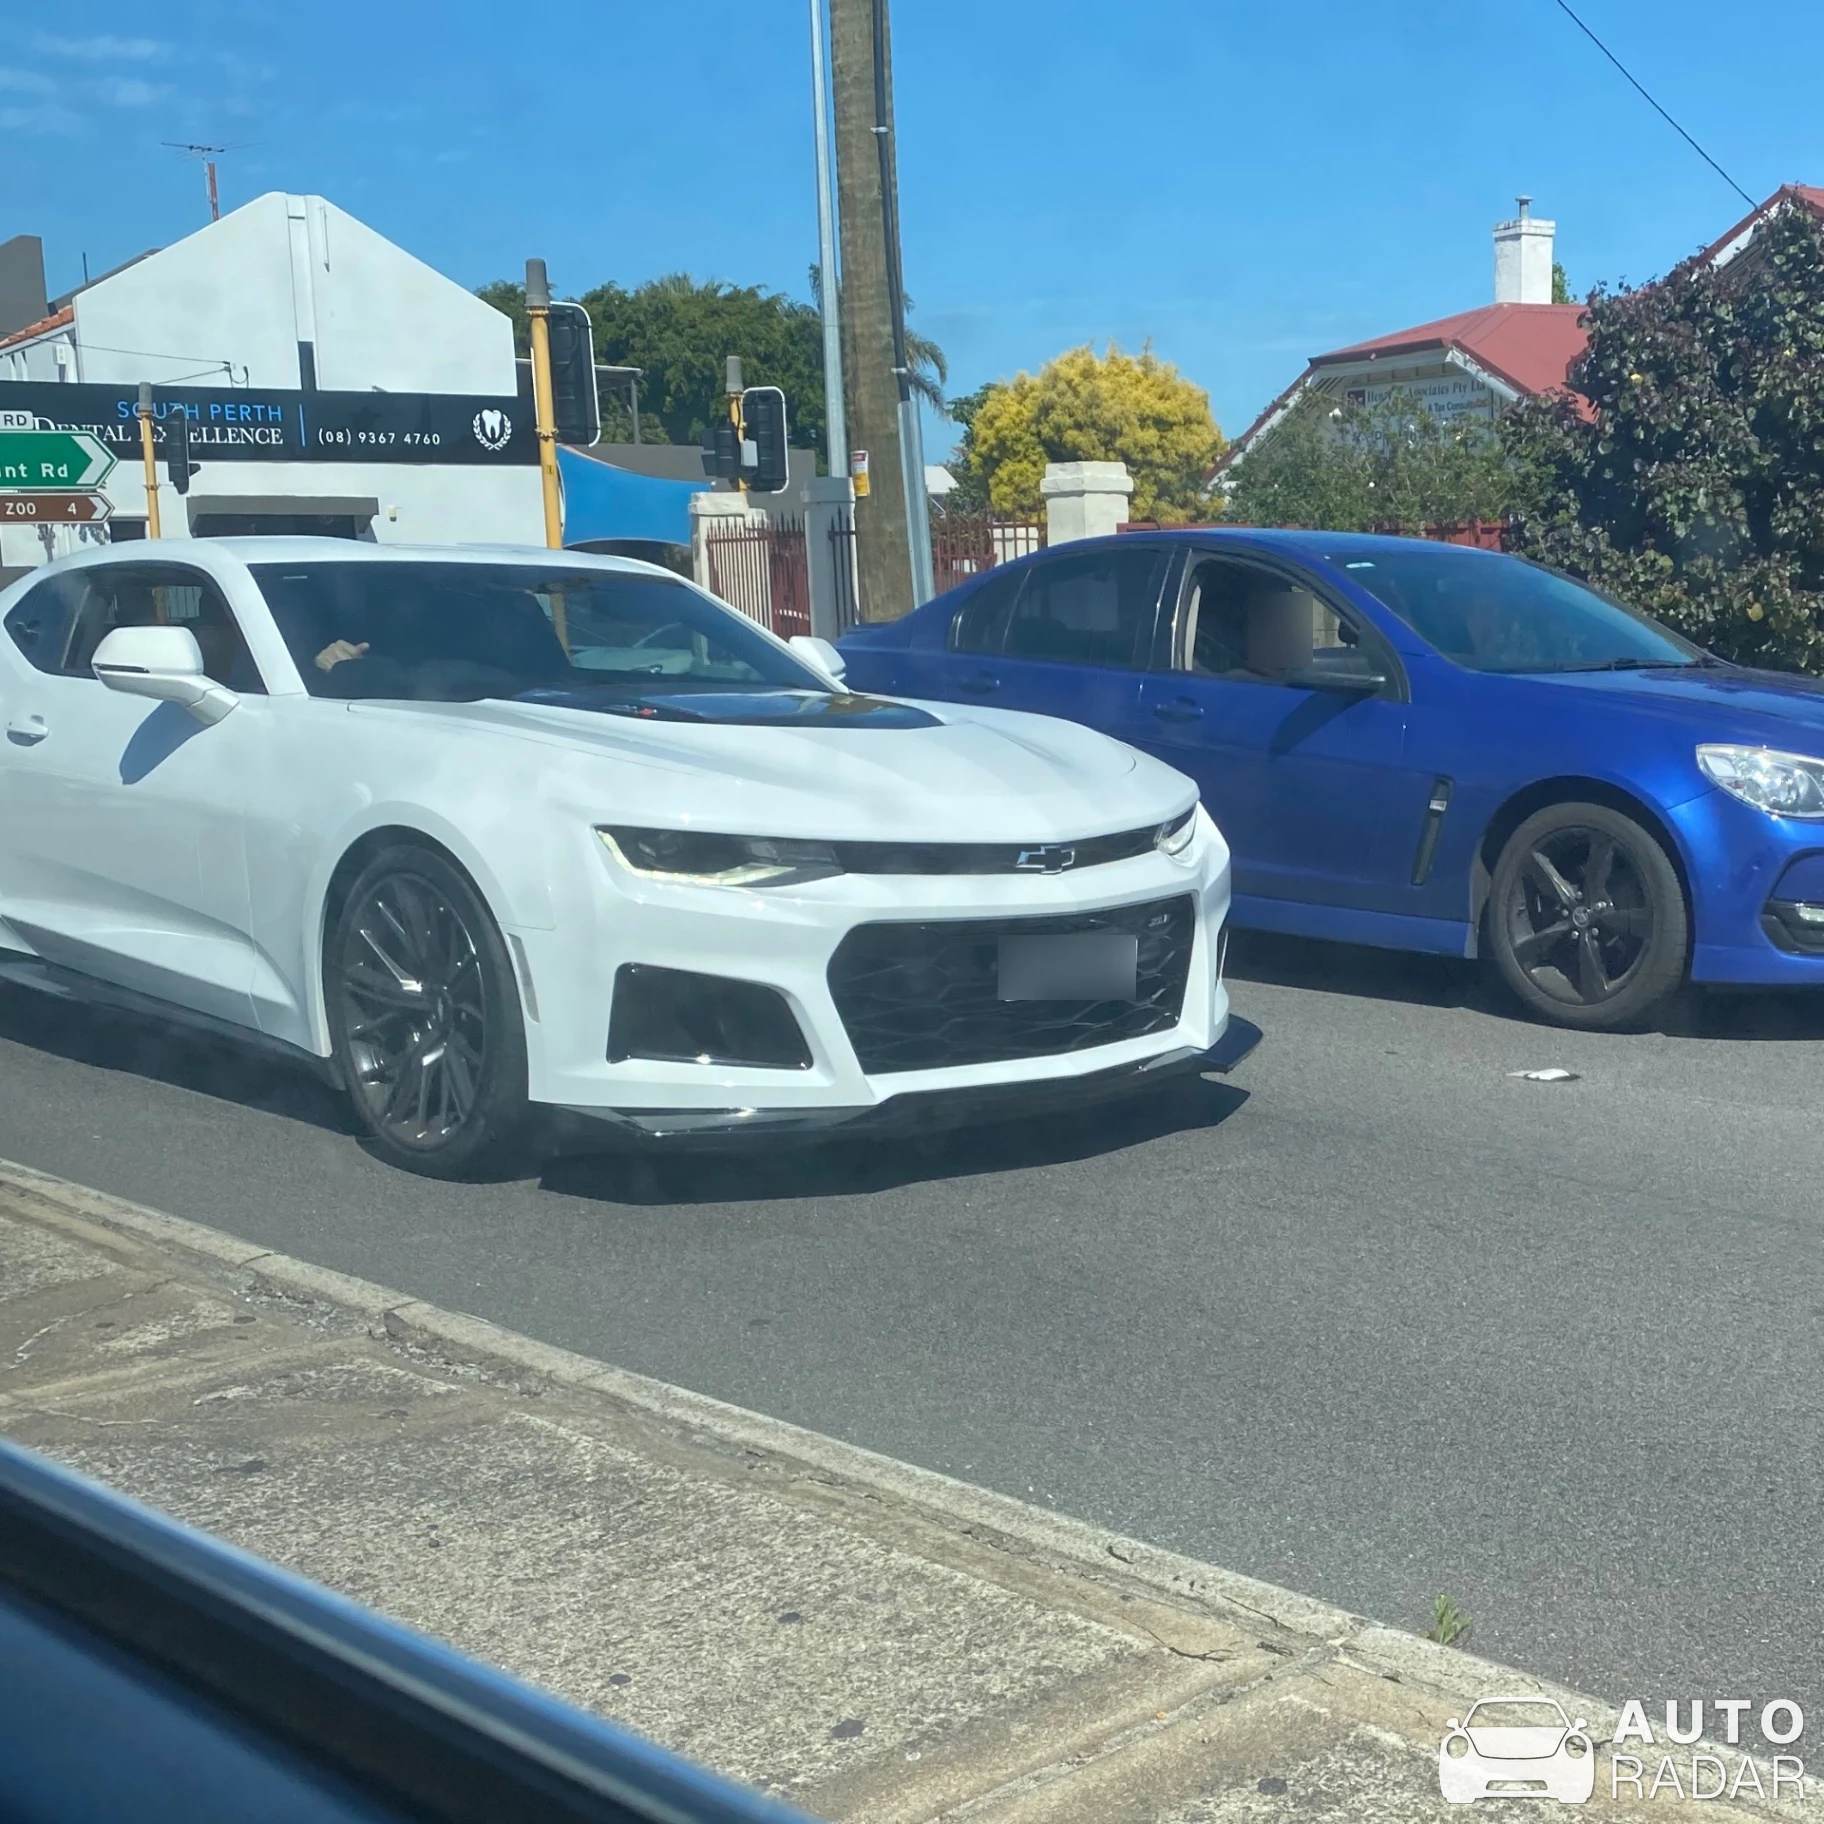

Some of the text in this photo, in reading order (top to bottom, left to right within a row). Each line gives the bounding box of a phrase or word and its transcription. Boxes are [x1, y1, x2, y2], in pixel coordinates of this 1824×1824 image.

[1452, 381, 1468, 398] Pty
[210, 404, 283, 422] PERTH
[1434, 402, 1446, 411] Tax
[3, 414, 28, 427] RD
[137, 419, 284, 445] XELLENCE
[318, 428, 441, 446] (08) 9367 4760
[0, 462, 69, 478] nt Rd
[5, 502, 77, 515] ZOO 4
